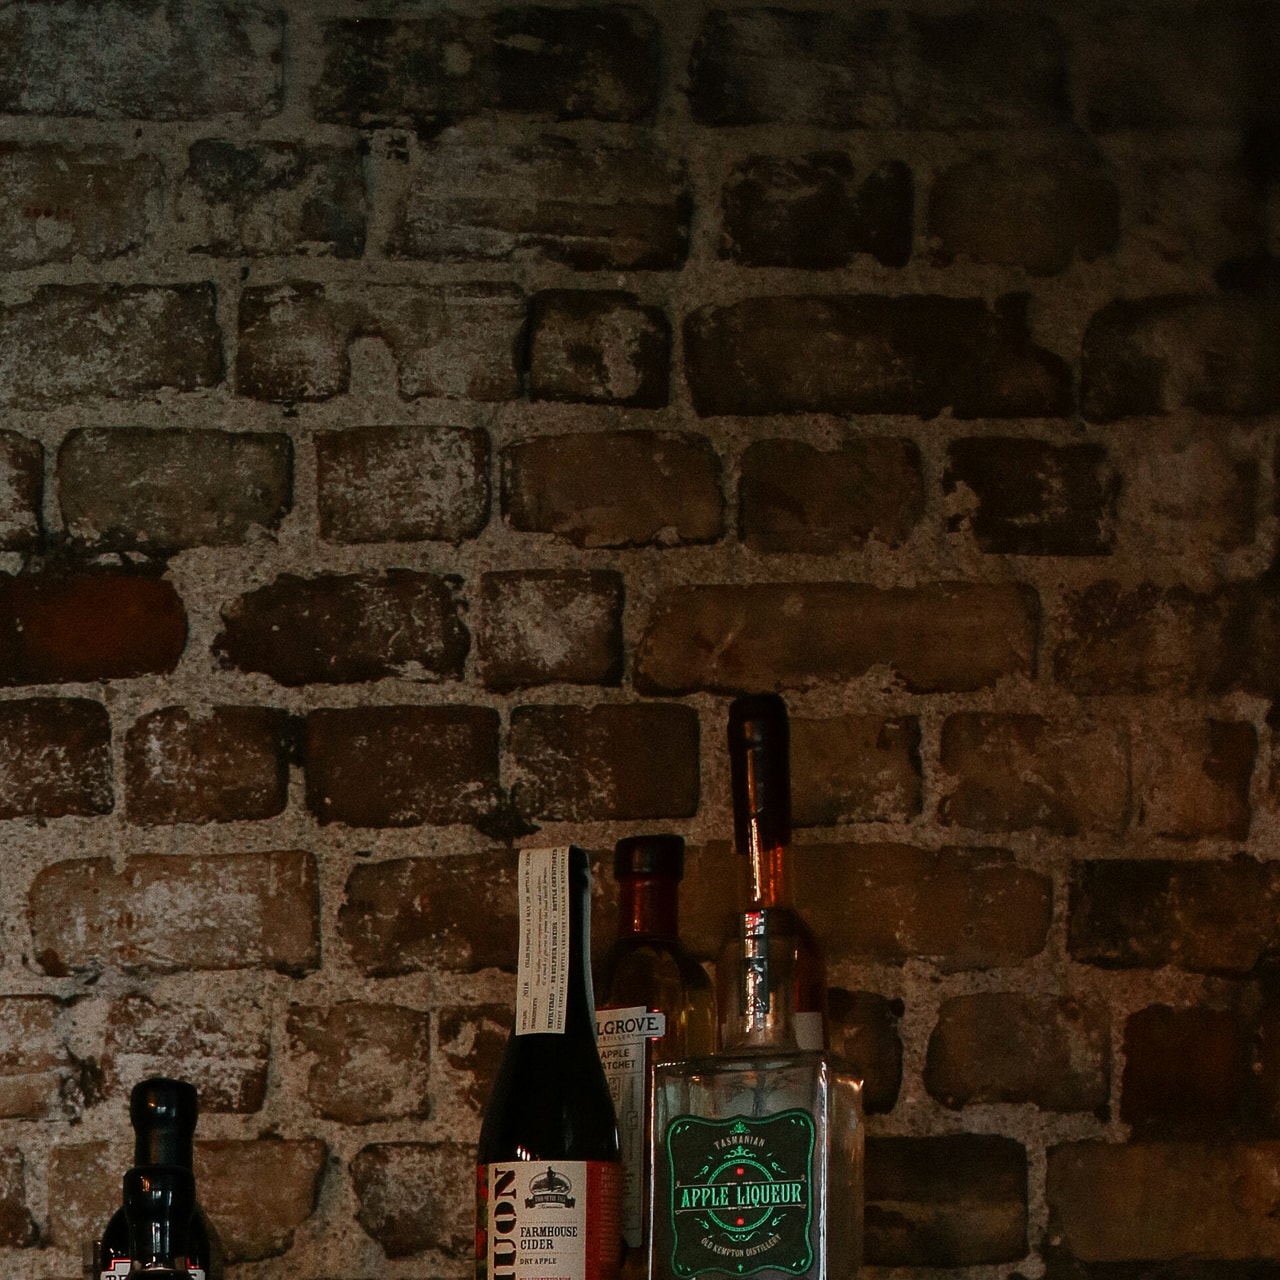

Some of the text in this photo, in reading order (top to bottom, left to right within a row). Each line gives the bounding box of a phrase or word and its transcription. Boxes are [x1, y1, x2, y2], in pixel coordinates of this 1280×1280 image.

[601, 1049, 629, 1059] APPLE
[714, 1135, 766, 1150] TASMANIAN
[681, 1183, 802, 1208] APPLE LIQUEUR
[520, 1226, 578, 1238] FARMHOUSE
[520, 1239, 554, 1250] CIDER
[700, 1233, 783, 1258] OLD KEMPTON DISTILLERY
